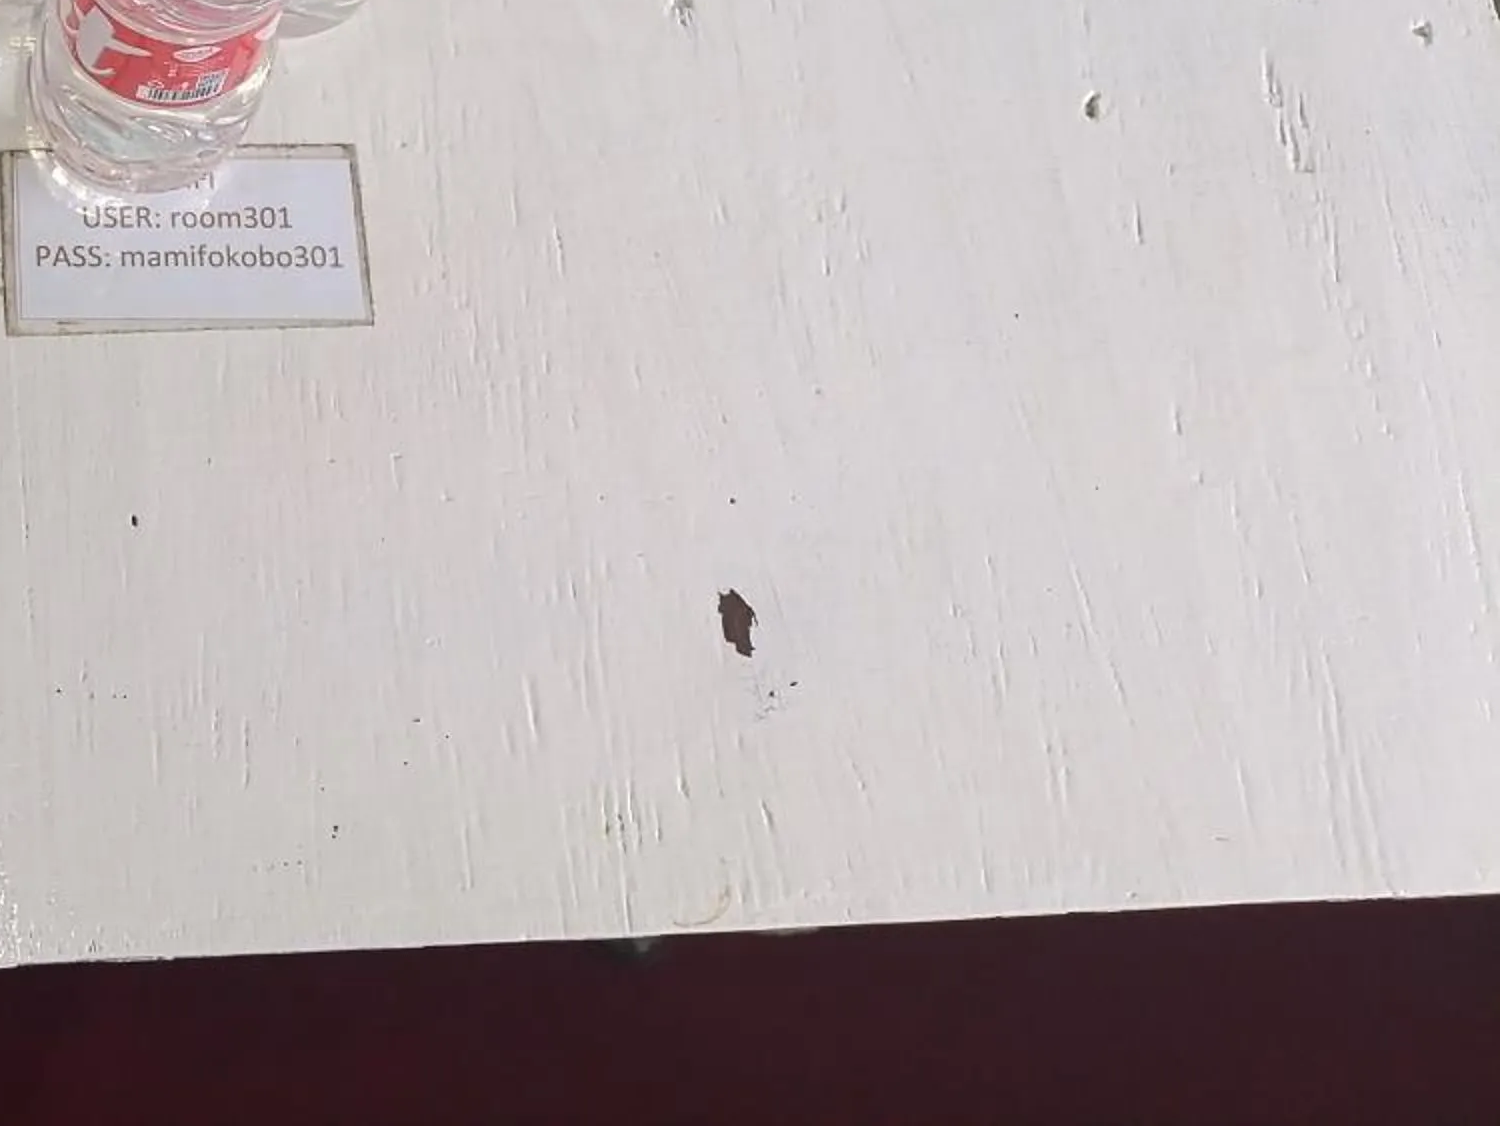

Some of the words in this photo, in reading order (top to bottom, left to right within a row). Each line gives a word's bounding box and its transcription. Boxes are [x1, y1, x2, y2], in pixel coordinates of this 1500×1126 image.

[83, 206, 161, 228] USER:
[171, 207, 293, 229] room301
[36, 245, 111, 267] PASS:
[121, 243, 344, 268] mamifokobo301
